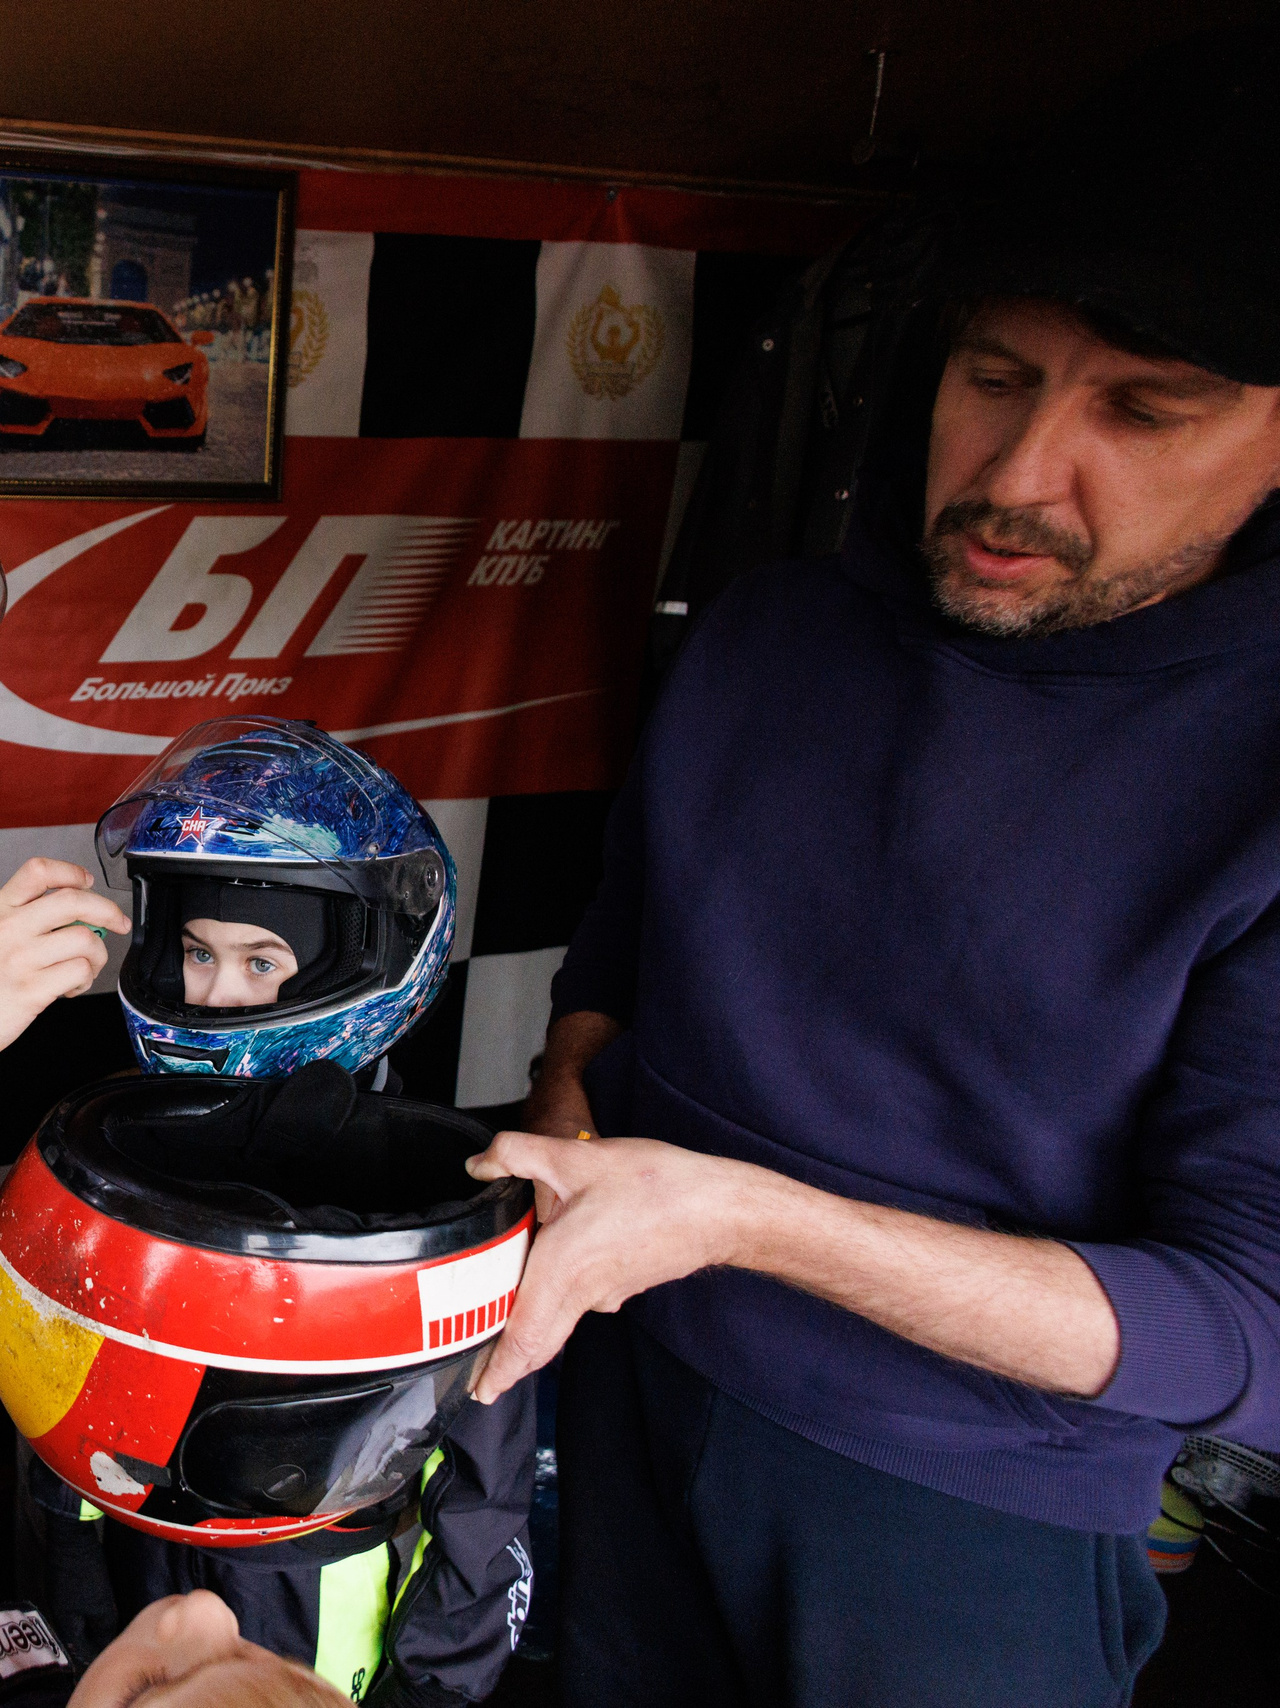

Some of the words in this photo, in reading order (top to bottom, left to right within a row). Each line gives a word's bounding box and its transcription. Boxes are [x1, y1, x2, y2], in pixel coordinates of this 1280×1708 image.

[485, 519, 620, 550] КАРТИНГ
[467, 554, 550, 586] КЛУБ
[98, 514, 483, 663] БП
[70, 673, 216, 702] Большой
[212, 672, 293, 702] Приз
